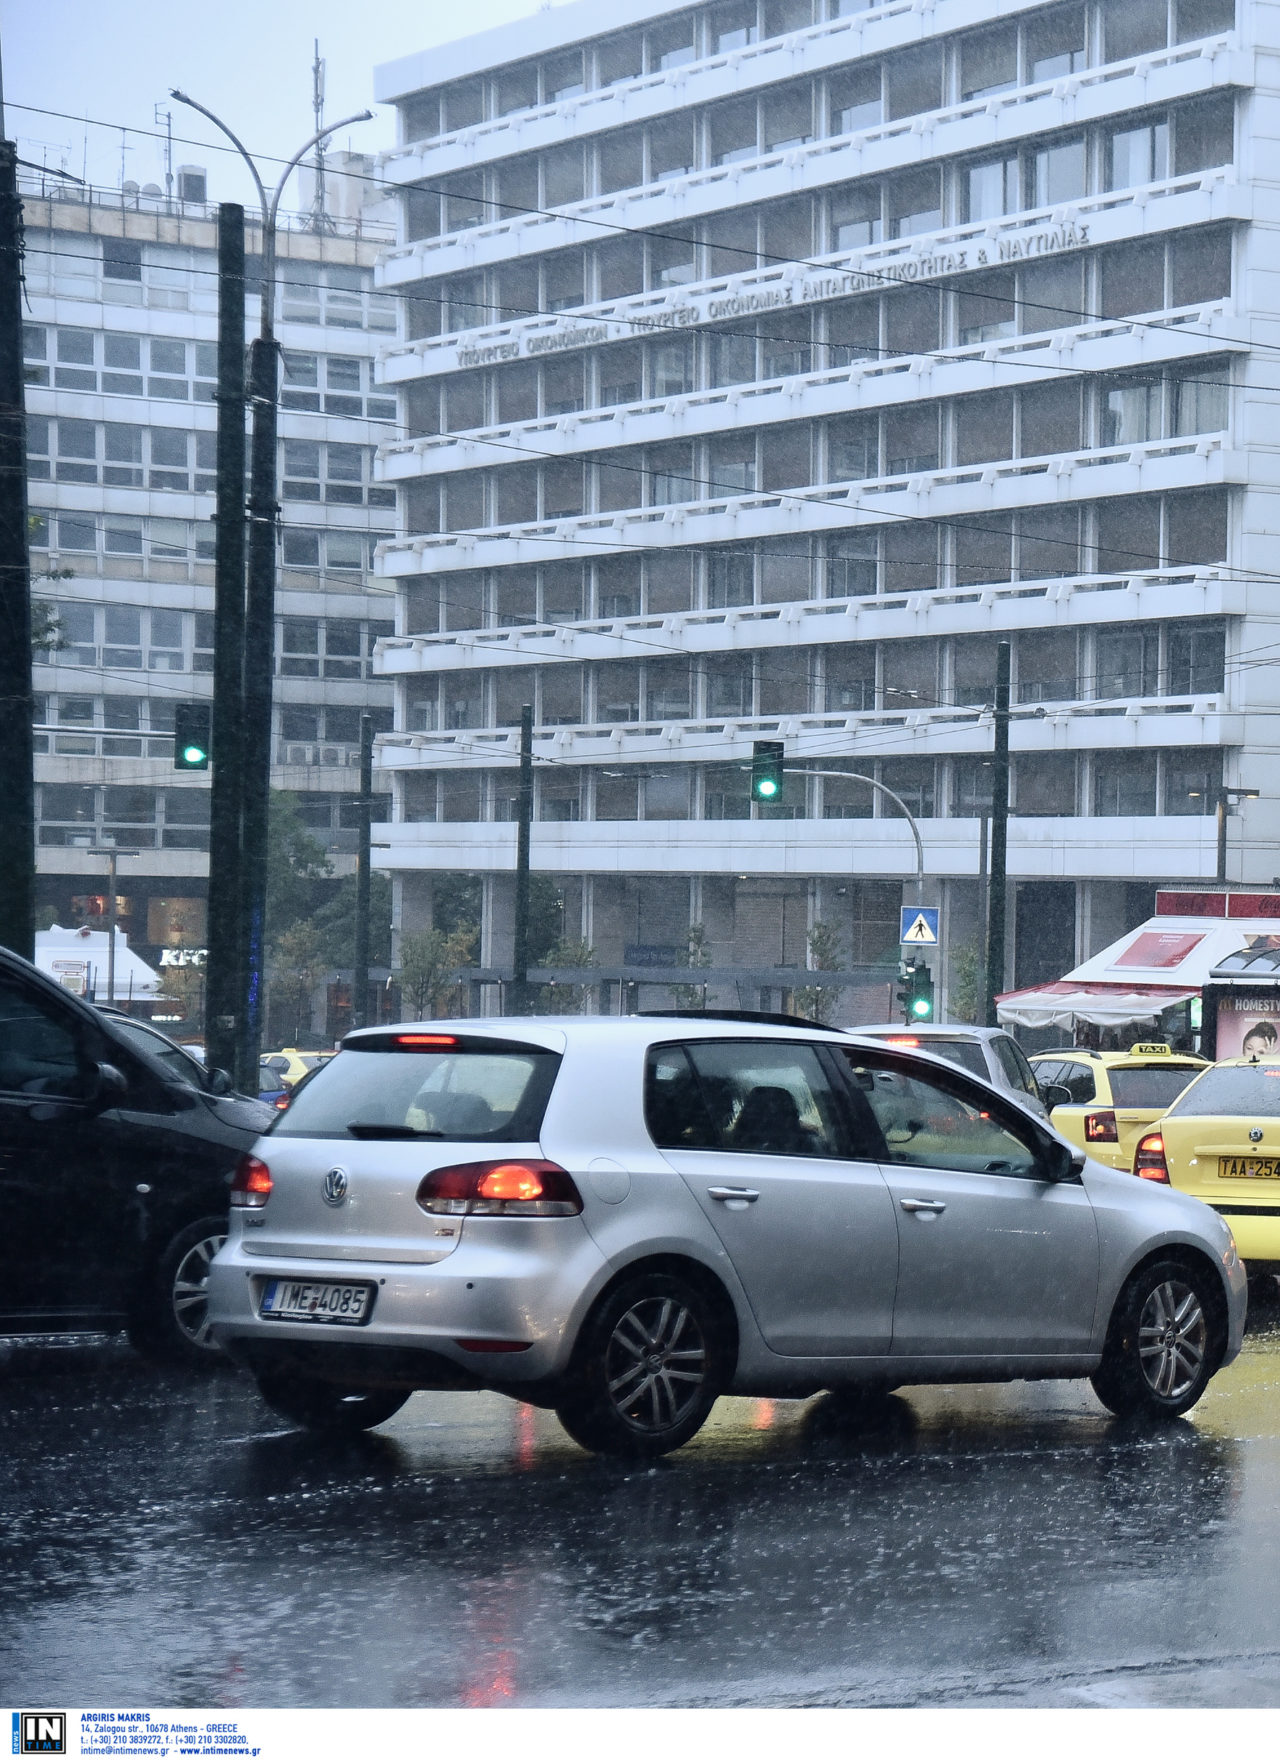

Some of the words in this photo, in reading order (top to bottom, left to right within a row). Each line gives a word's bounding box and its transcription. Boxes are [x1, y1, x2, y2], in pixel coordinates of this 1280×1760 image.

[978, 249, 988, 264] &
[999, 224, 1090, 260] ΝΑΥΤΙΛΙΑΣ
[160, 949, 208, 966] KFC
